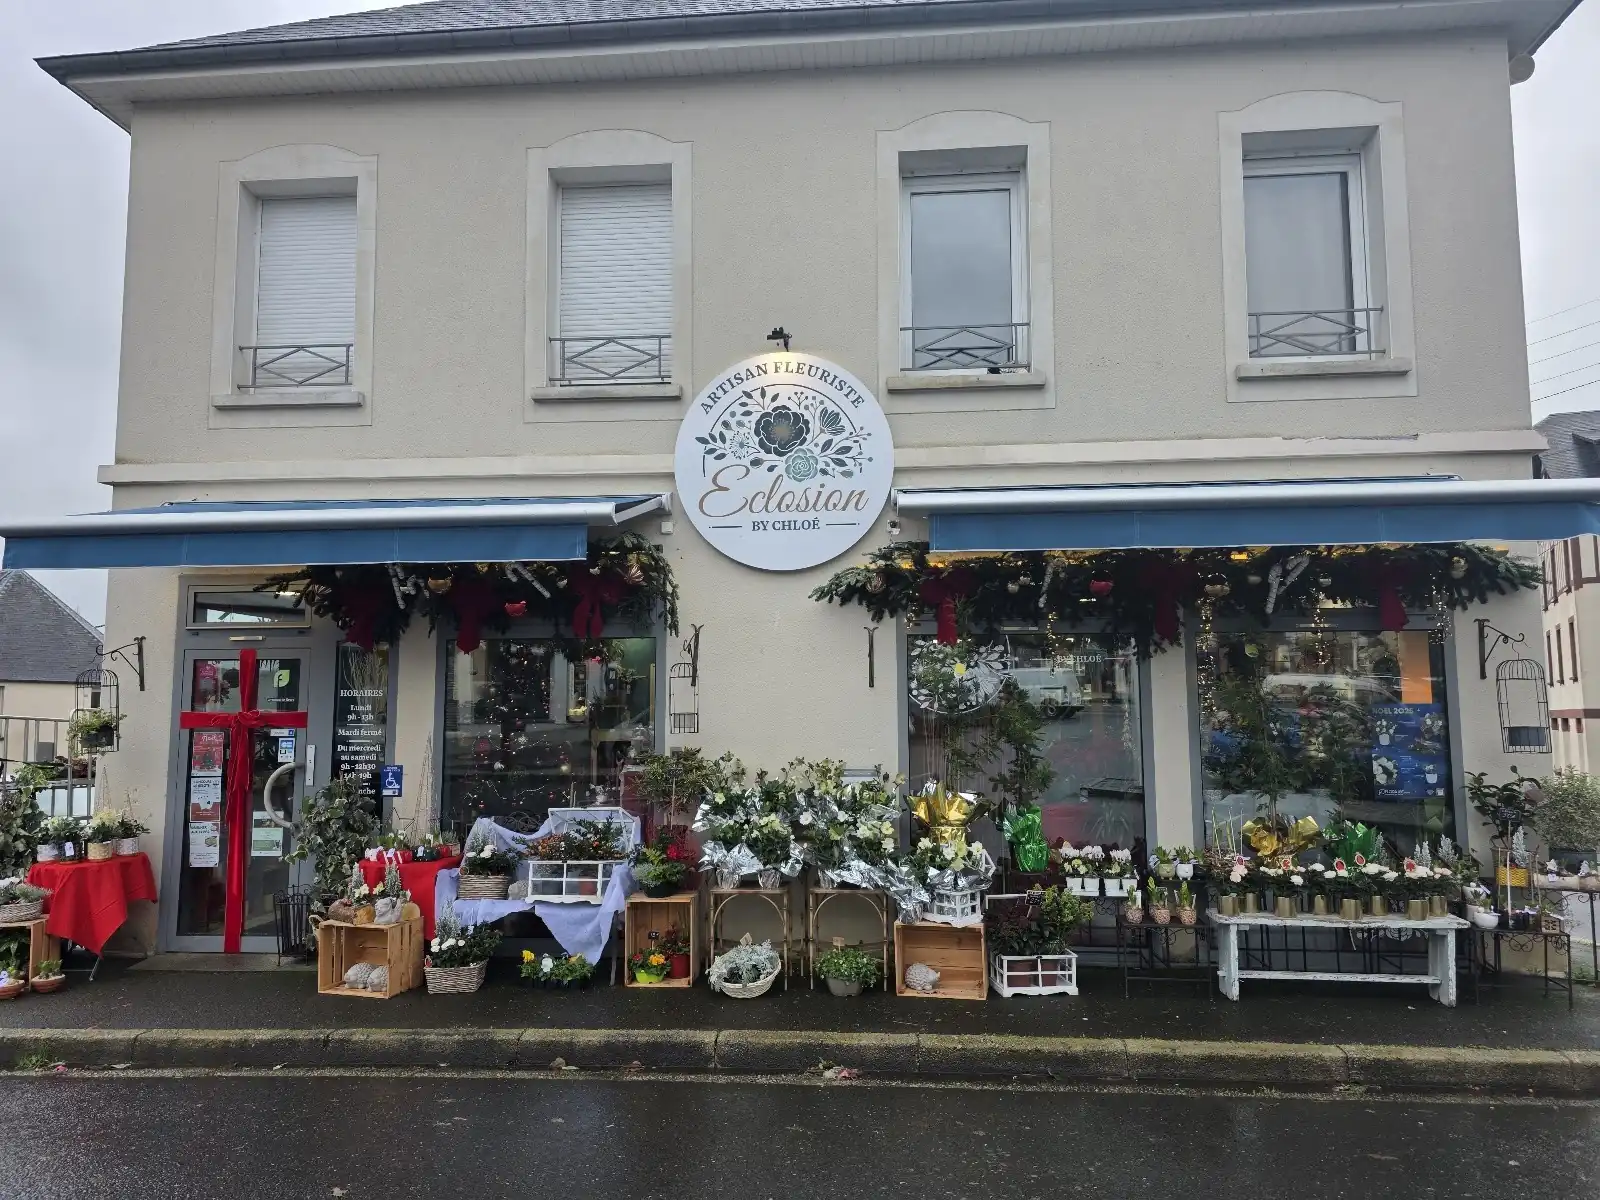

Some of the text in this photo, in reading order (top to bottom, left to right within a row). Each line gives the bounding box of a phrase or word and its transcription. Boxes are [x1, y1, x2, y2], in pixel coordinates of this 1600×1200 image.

[700, 361, 865, 415] ARTISAN FLEURISTE
[698, 464, 870, 518] Eclosion
[751, 517, 821, 532] BY CHLOÉ
[340, 689, 384, 697] HORAIRES
[347, 713, 357, 721] 9h
[360, 728, 382, 737] fermé
[337, 744, 381, 752] Du mercredi
[350, 753, 377, 761] samedi
